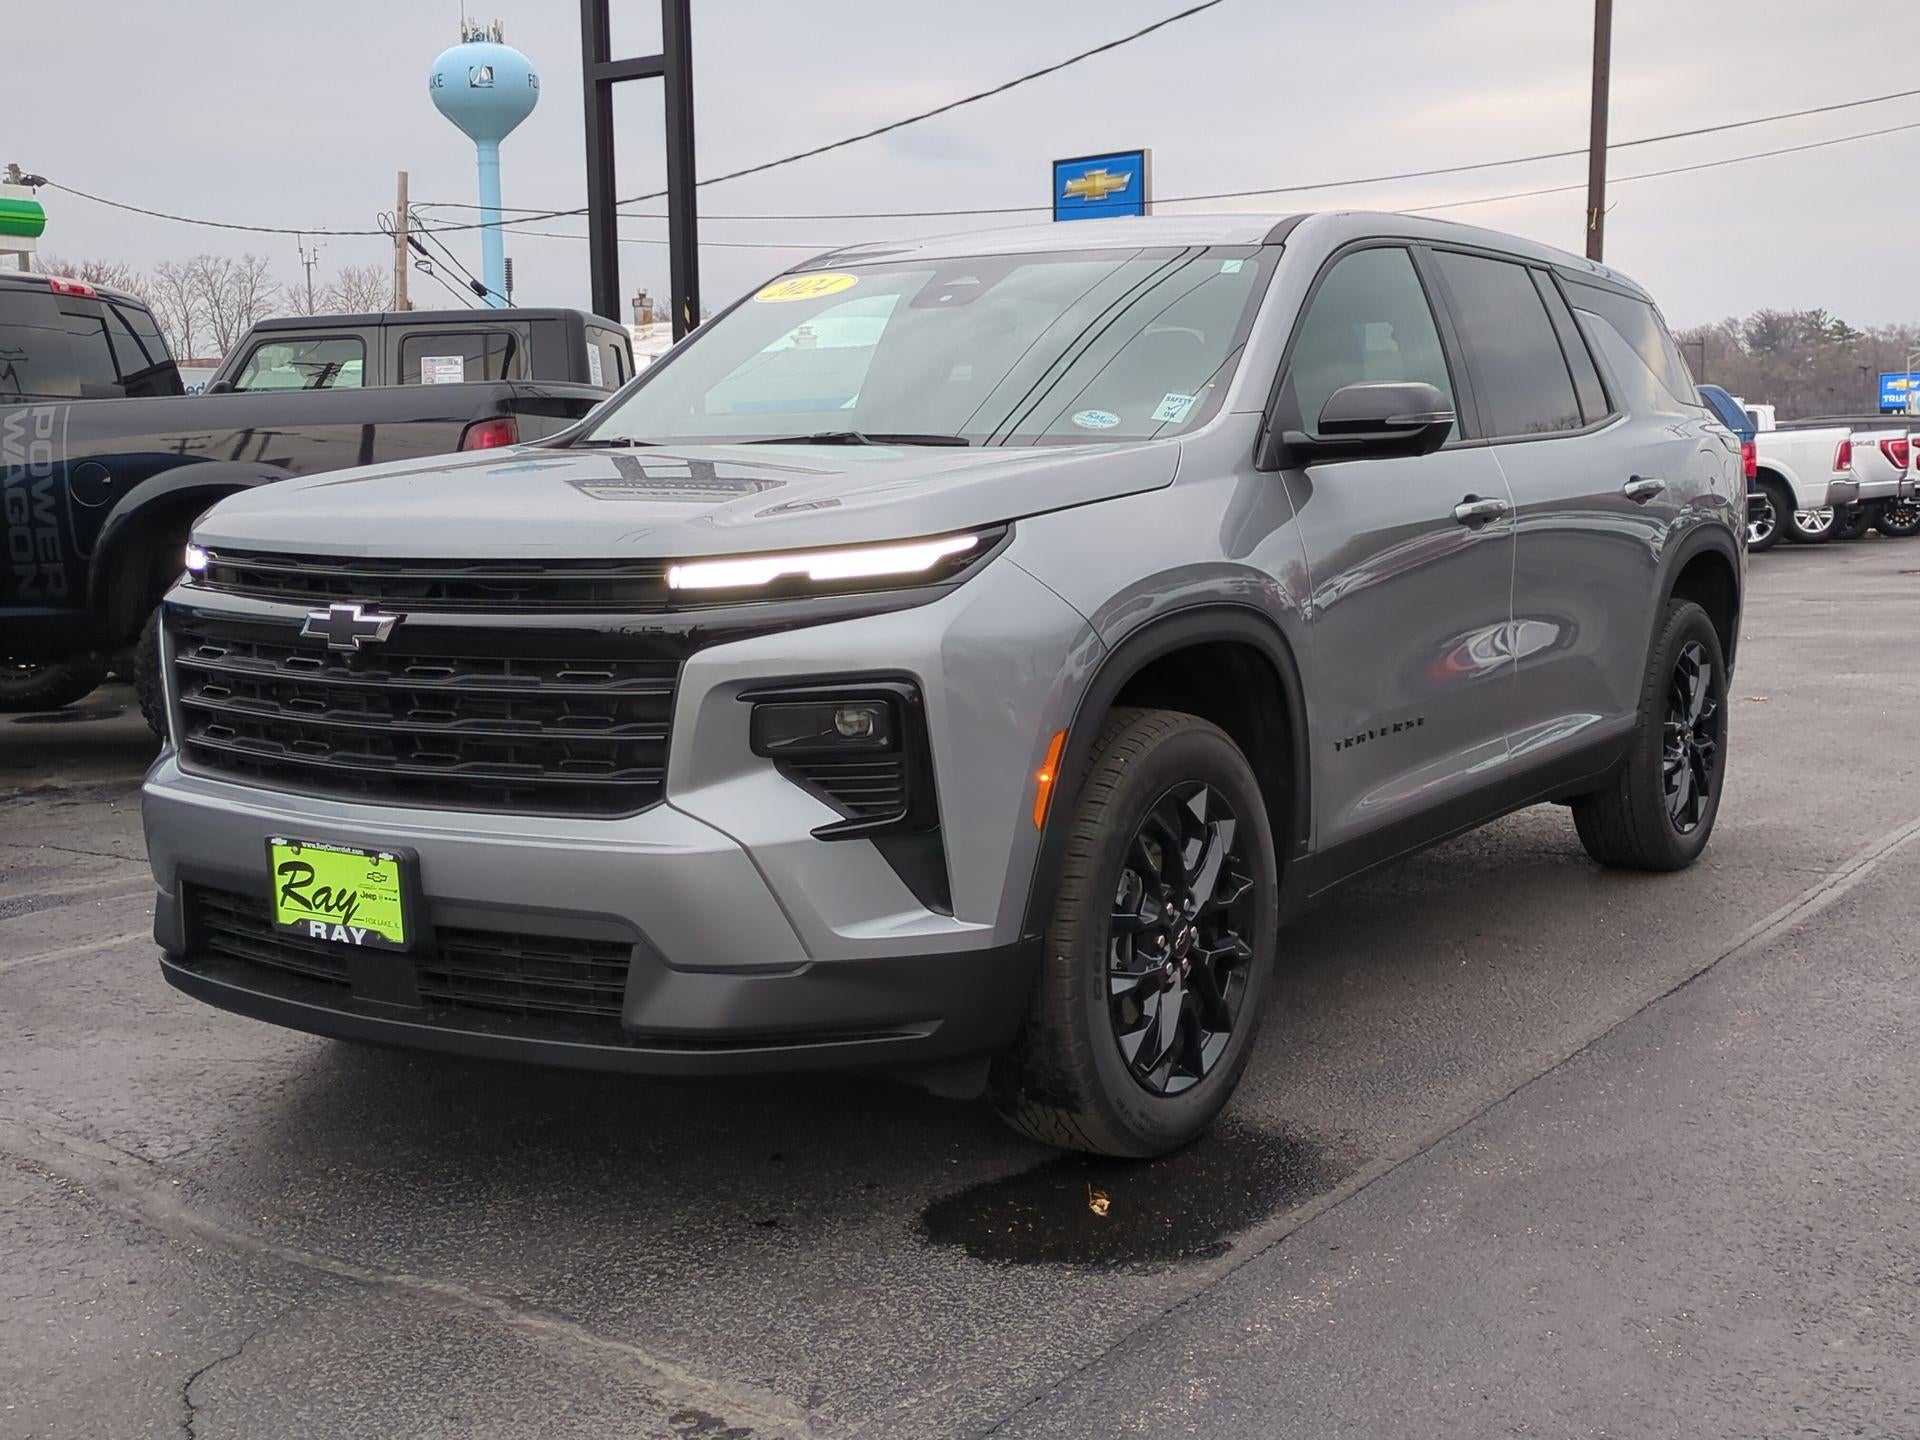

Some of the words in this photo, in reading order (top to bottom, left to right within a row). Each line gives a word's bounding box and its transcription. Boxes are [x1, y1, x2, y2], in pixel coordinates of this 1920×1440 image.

[1164, 395, 1194, 405] SAFETY
[3, 407, 42, 599] WAGON
[29, 406, 68, 597] POWER
[1333, 716, 1425, 752] TRAVERSE
[277, 861, 361, 925] Ray
[360, 890, 377, 901] Jeep
[309, 920, 368, 945] RAY
